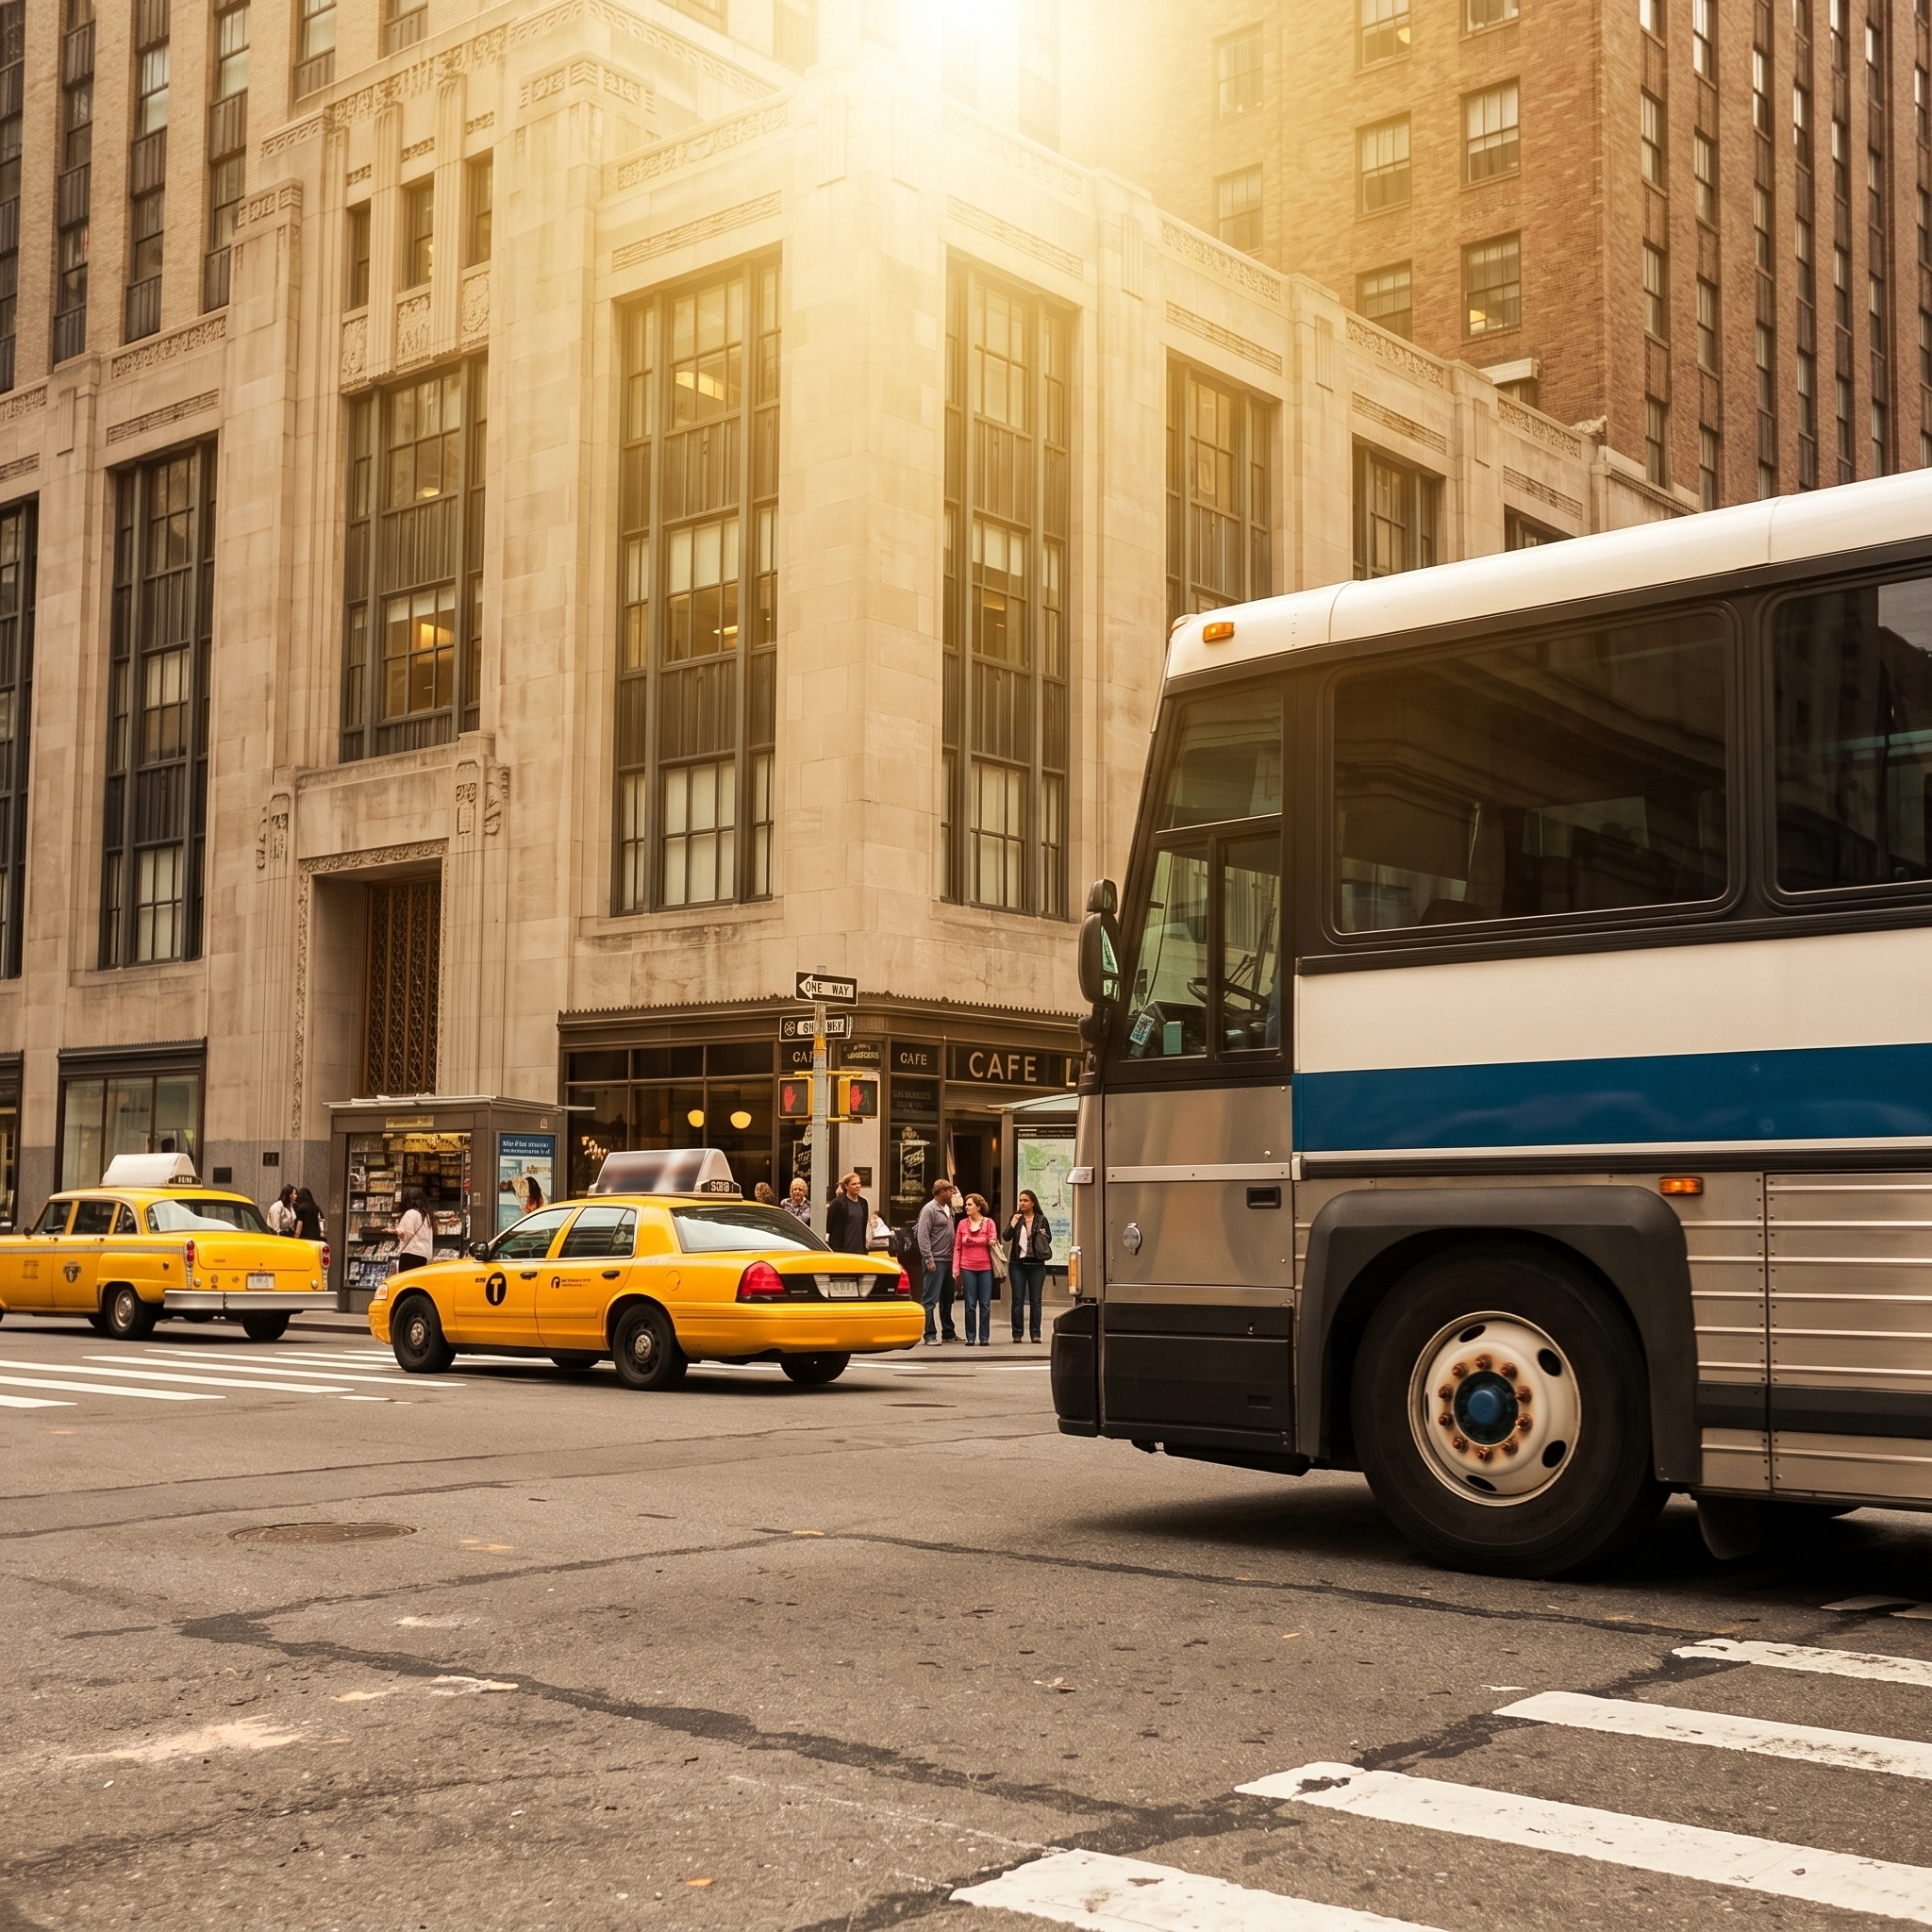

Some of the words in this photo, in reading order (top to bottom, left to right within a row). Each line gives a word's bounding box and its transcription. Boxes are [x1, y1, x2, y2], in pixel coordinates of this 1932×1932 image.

[806, 981, 823, 993] ONE
[832, 984, 850, 996] WAY
[792, 1051, 814, 1063] CAF
[900, 1052, 927, 1066] CAFE
[969, 1051, 1037, 1082] CAFE
[1065, 1058, 1077, 1087] L
[491, 1277, 503, 1302] T
